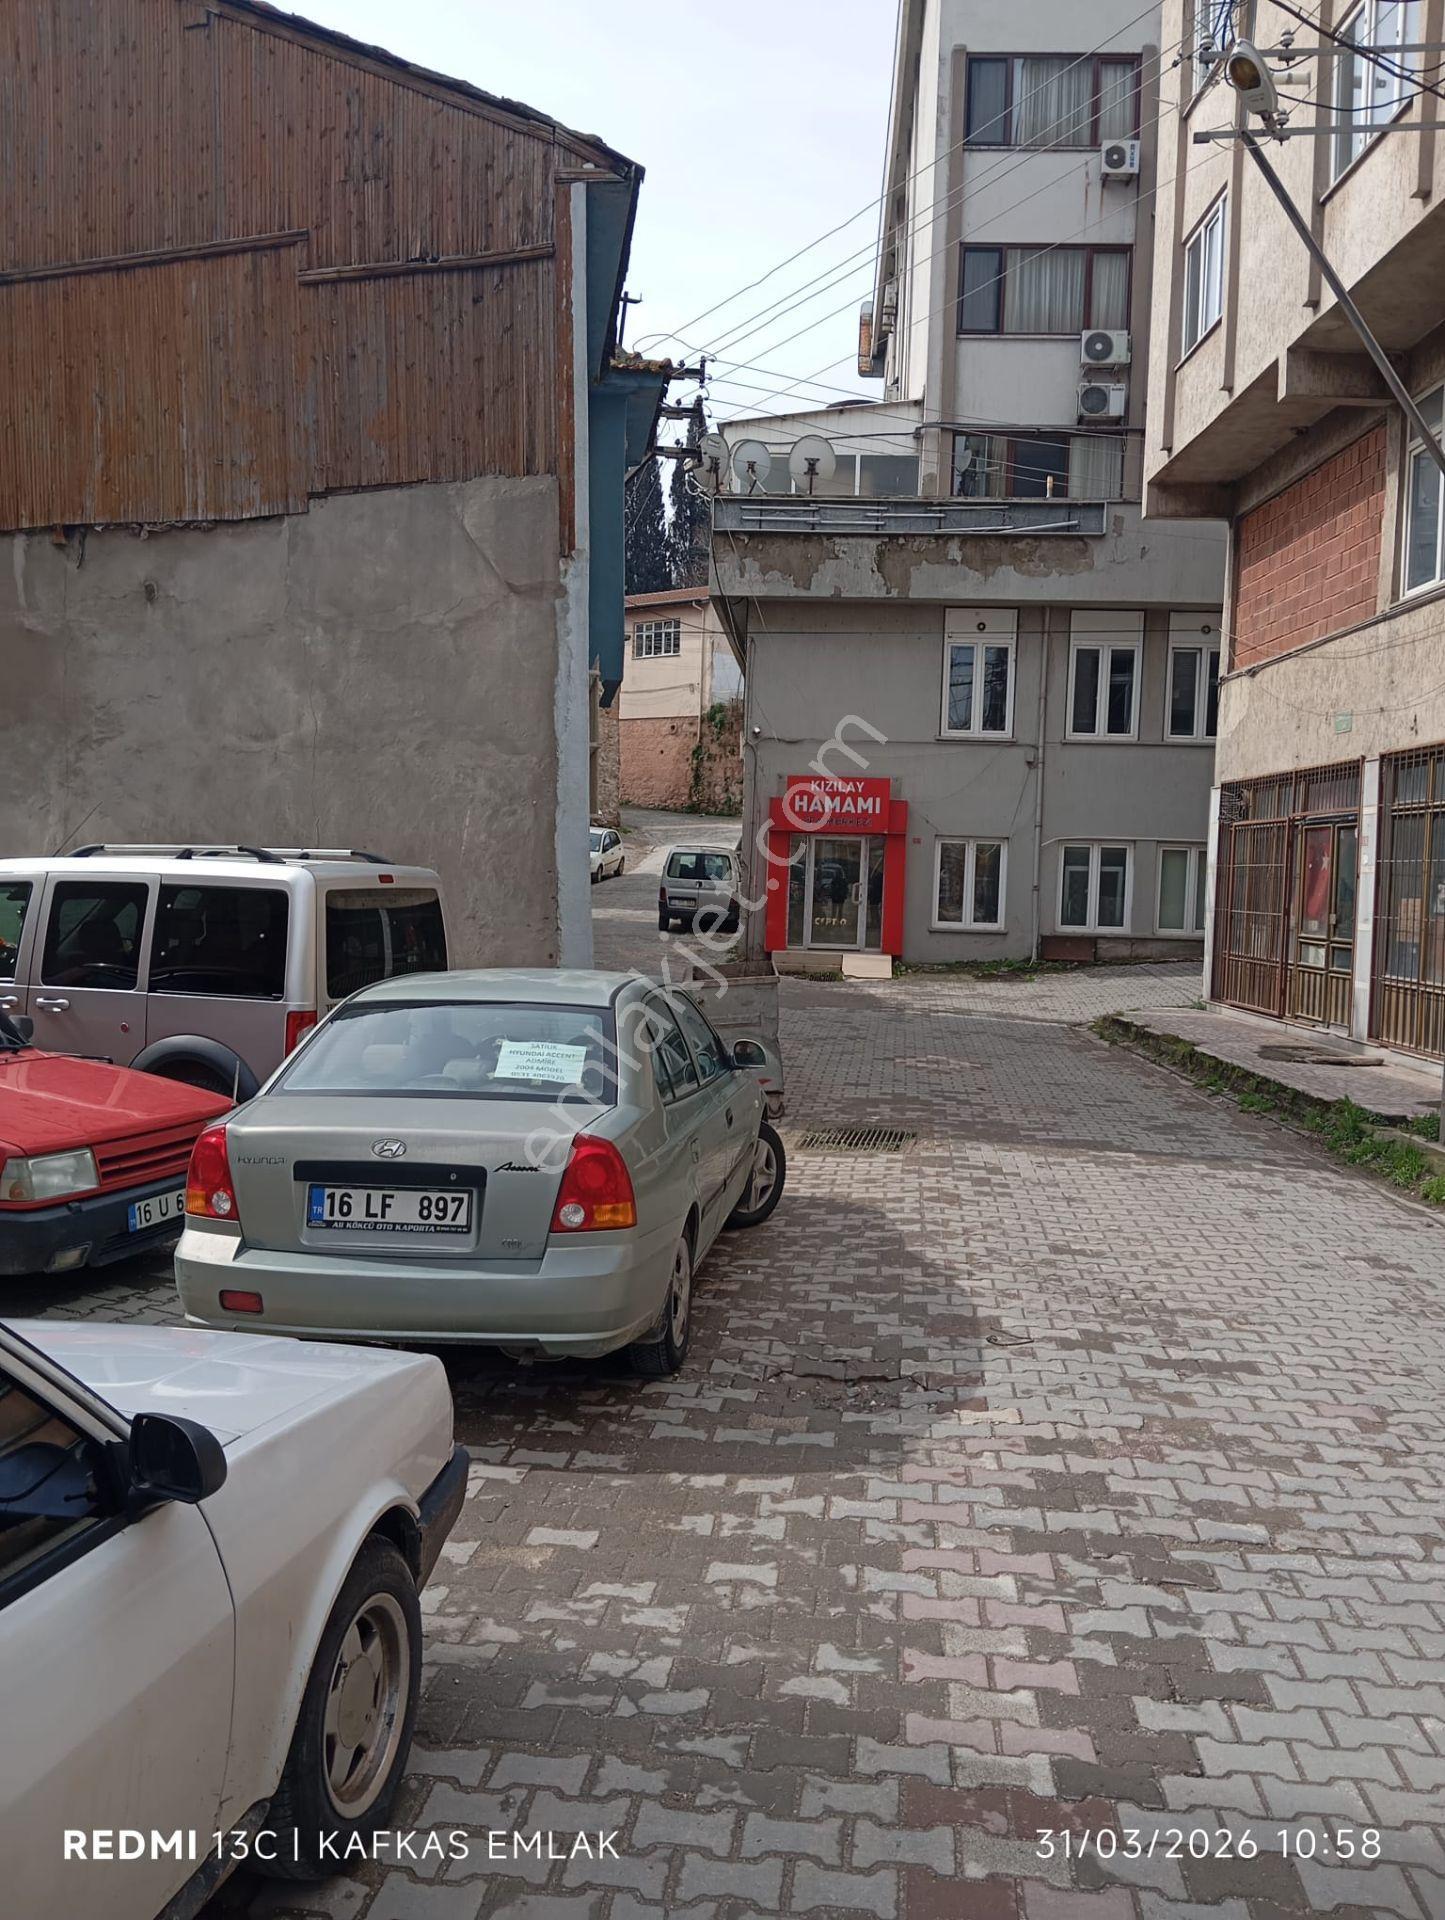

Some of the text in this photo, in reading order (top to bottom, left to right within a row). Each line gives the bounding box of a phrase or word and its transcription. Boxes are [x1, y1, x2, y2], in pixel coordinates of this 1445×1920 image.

[810, 780, 864, 793] KIZILAY
[794, 795, 880, 814] HAMAMI
[137, 1202, 152, 1225] 16
[158, 1196, 168, 1217] U
[313, 1192, 465, 1222] TR 16 LF 897
[394, 1224, 435, 1232] KAPORTA
